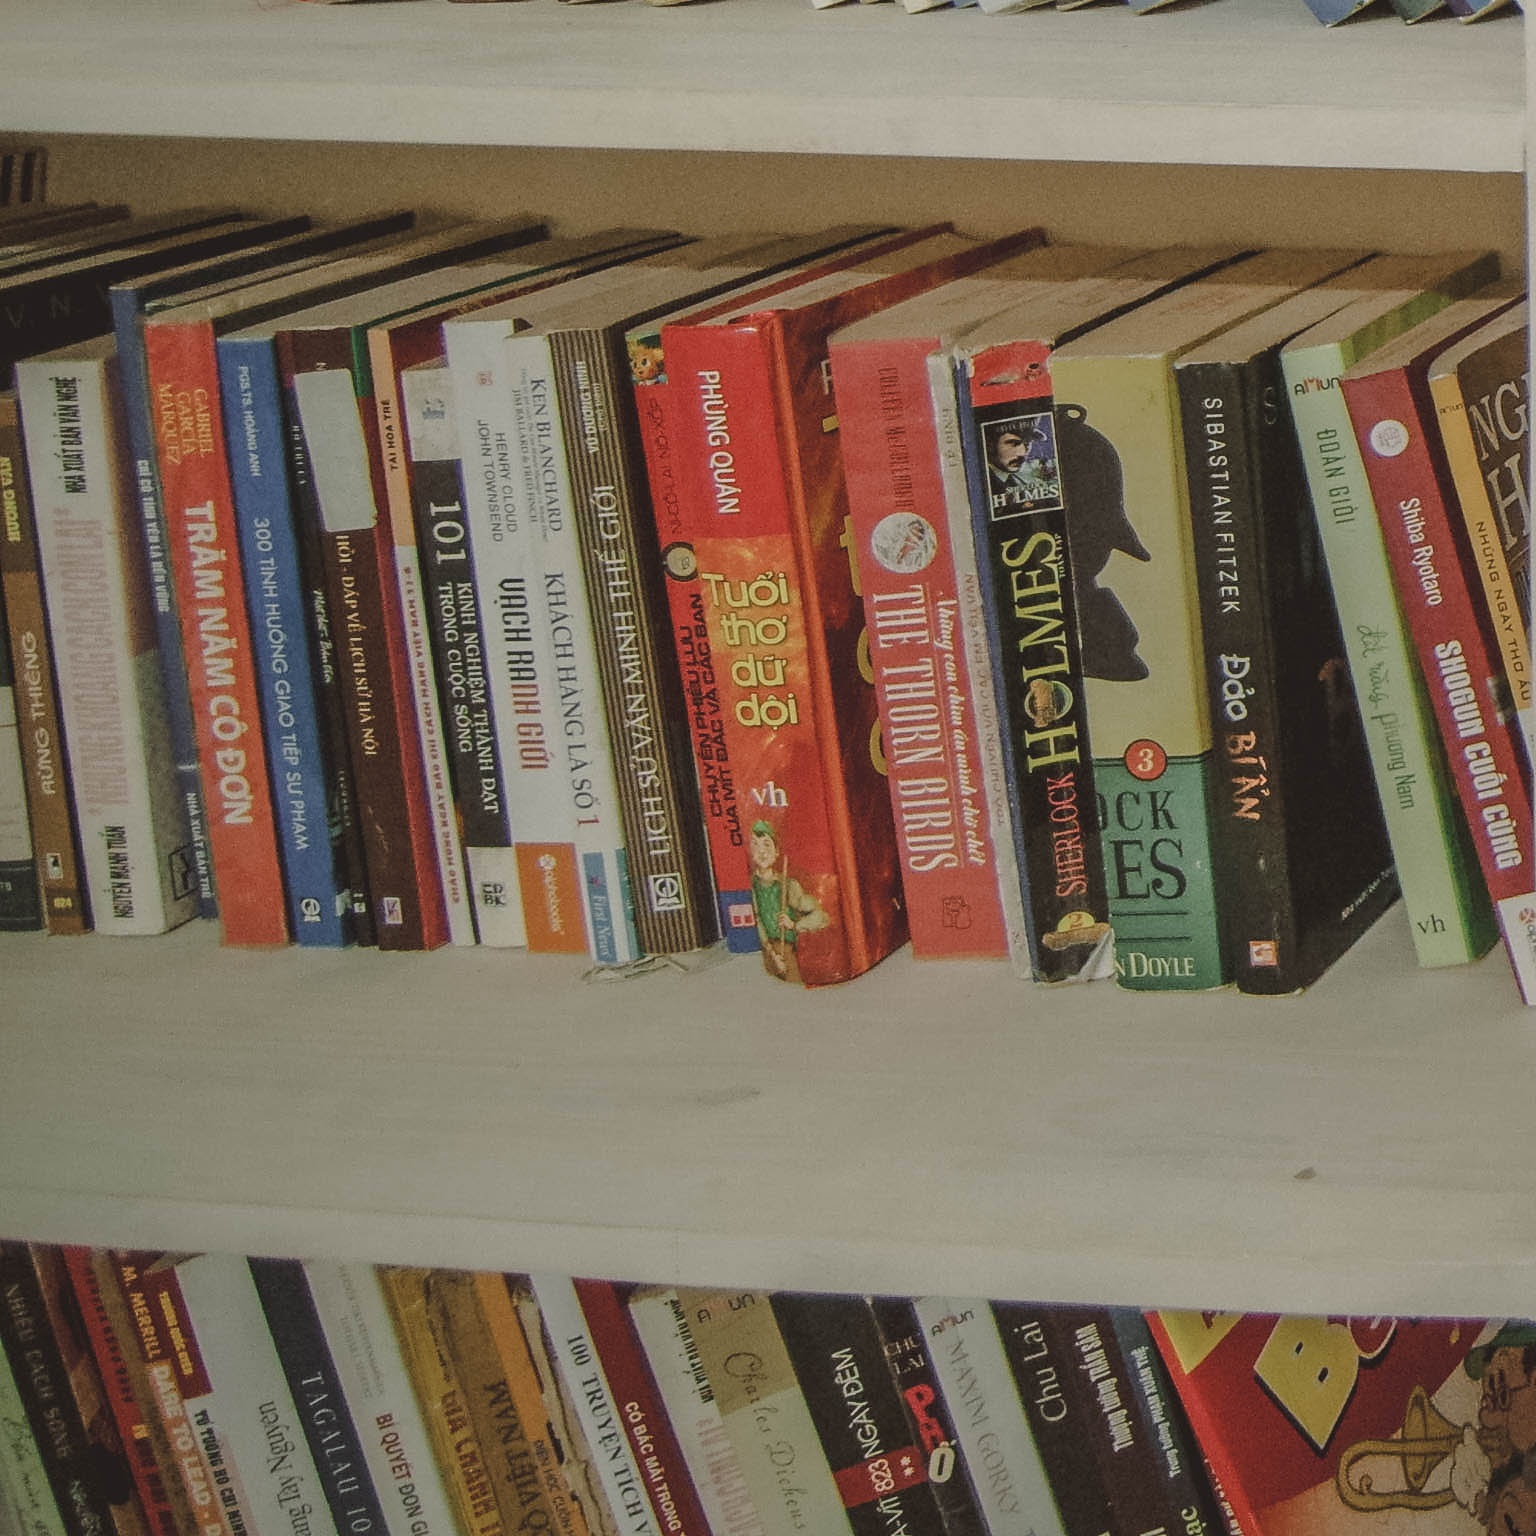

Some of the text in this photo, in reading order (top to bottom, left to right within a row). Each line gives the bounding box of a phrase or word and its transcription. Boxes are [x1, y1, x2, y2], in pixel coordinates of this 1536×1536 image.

[476, 419, 504, 543] JOHN TOWNSEND
[501, 485, 518, 532] CLOUD
[535, 421, 562, 532] BLANCHARD
[1216, 532, 1240, 612] FITZEK
[1399, 497, 1442, 606] Shiba Ryotaro
[253, 518, 273, 552] 300
[274, 679, 295, 727] GIAO
[208, 694, 248, 742] CÔ
[875, 584, 953, 872] THE THORN BIRDS
[1435, 641, 1483, 737] SHOGUN
[567, 1334, 591, 1366] 100
[1035, 1366, 1068, 1423] Chu
